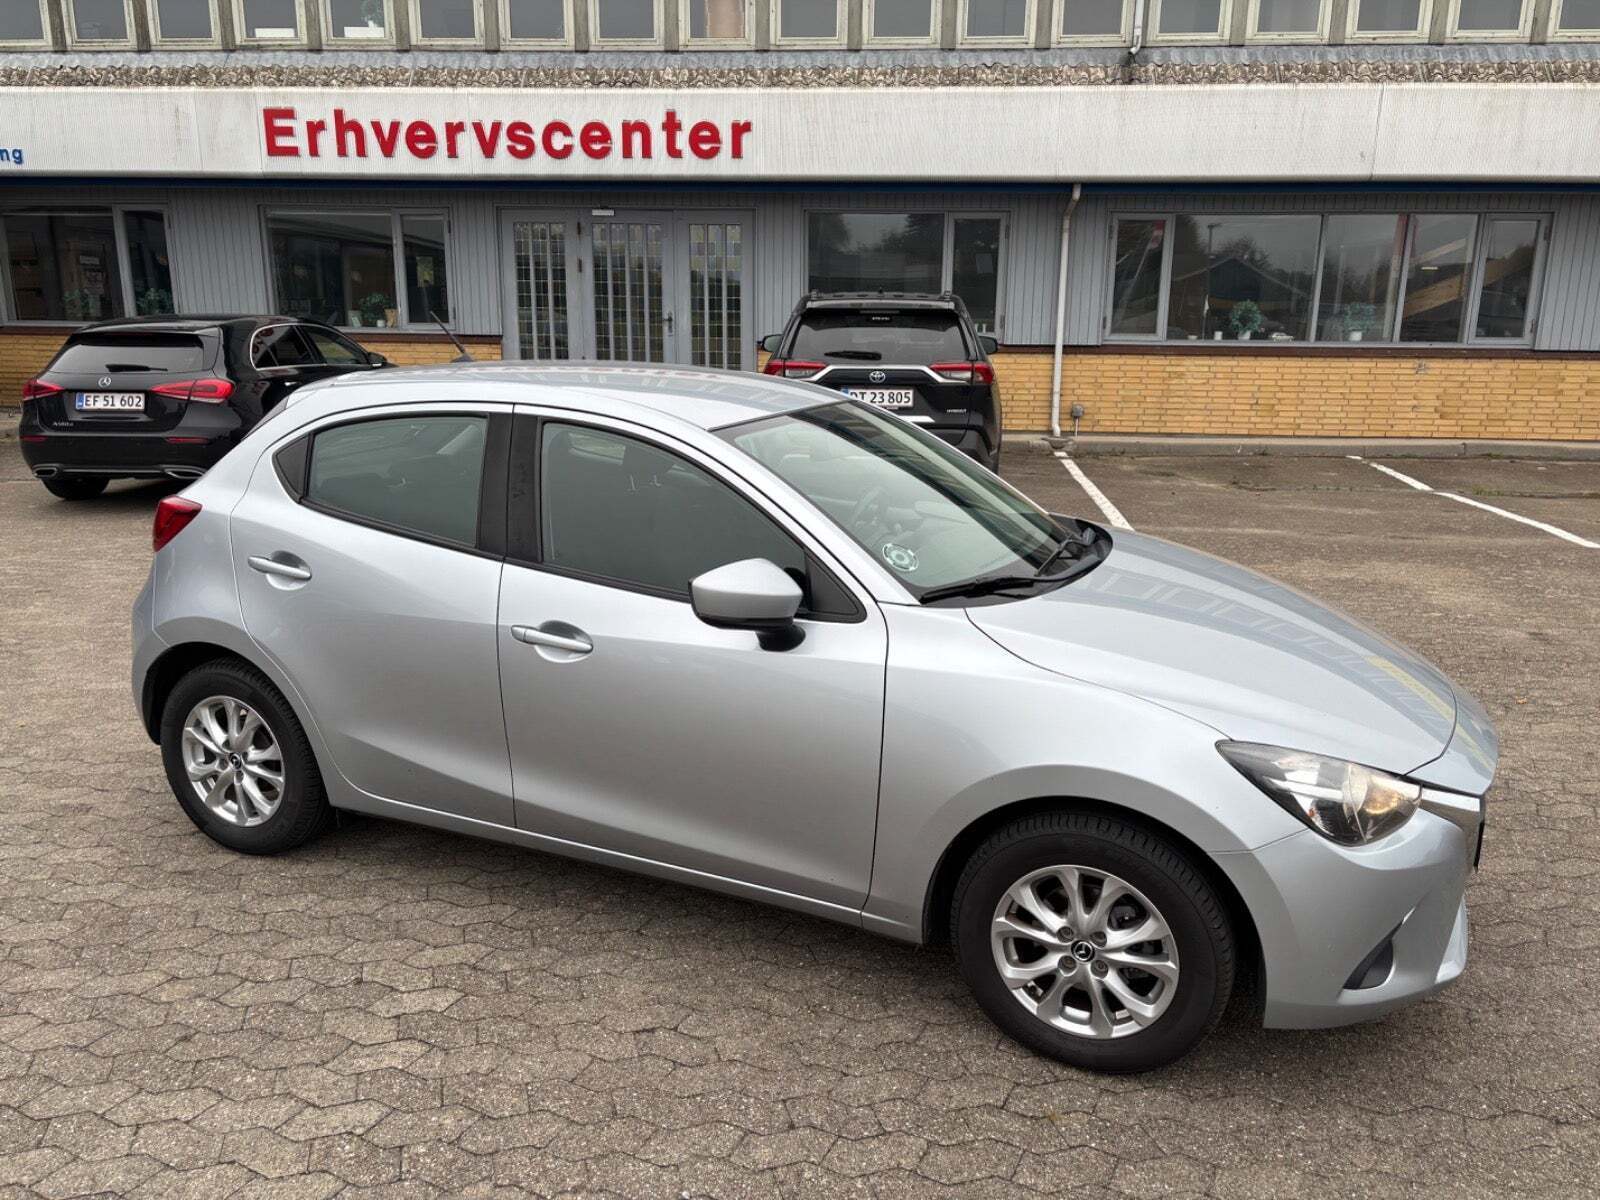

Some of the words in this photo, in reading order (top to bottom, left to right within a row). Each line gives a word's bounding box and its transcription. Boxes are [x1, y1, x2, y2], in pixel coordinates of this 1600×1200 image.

[263, 107, 752, 160] Erhvervscenter
[84, 395, 100, 407] EF
[103, 395, 116, 407] 51
[119, 395, 142, 408] 602
[870, 391, 885, 404] 23
[888, 391, 911, 404] 805
